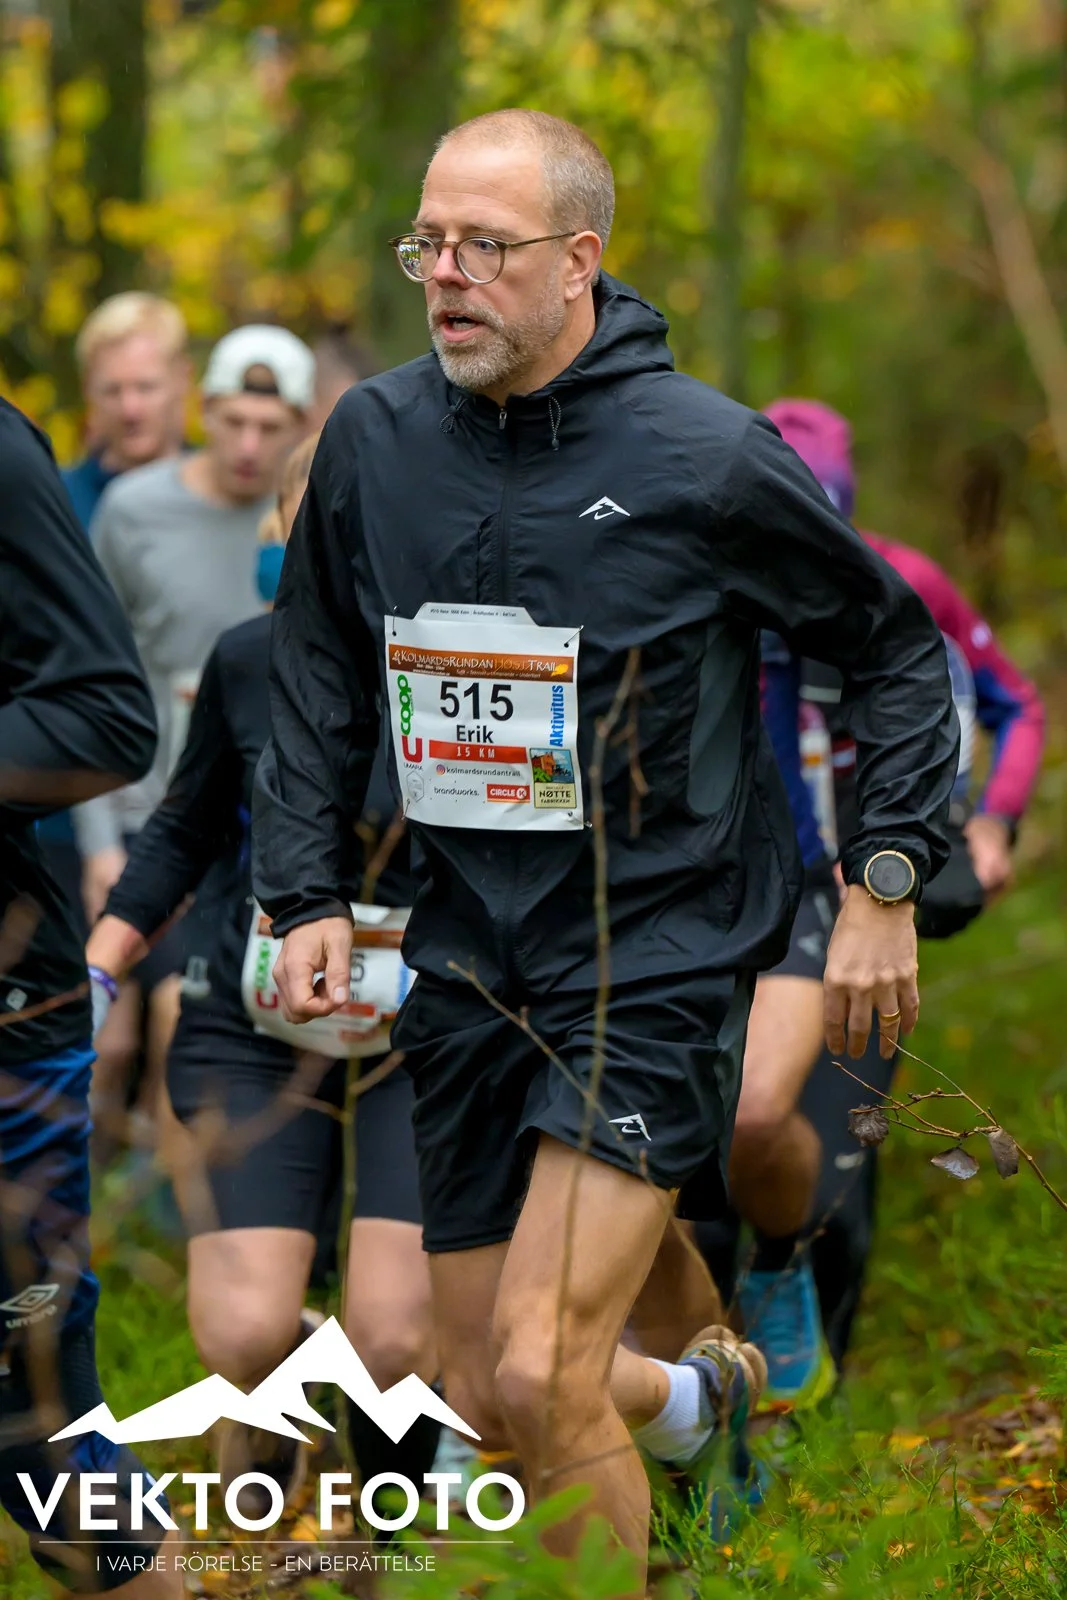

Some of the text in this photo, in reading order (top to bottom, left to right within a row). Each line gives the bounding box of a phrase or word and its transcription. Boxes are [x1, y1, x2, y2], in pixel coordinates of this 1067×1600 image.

[397, 674, 412, 735] coop
[440, 681, 513, 721] 515
[550, 685, 564, 747] Aktivitus
[456, 725, 494, 744] Erik
[490, 788, 516, 797] CIRCLE
[540, 790, 572, 798] NØTTE
